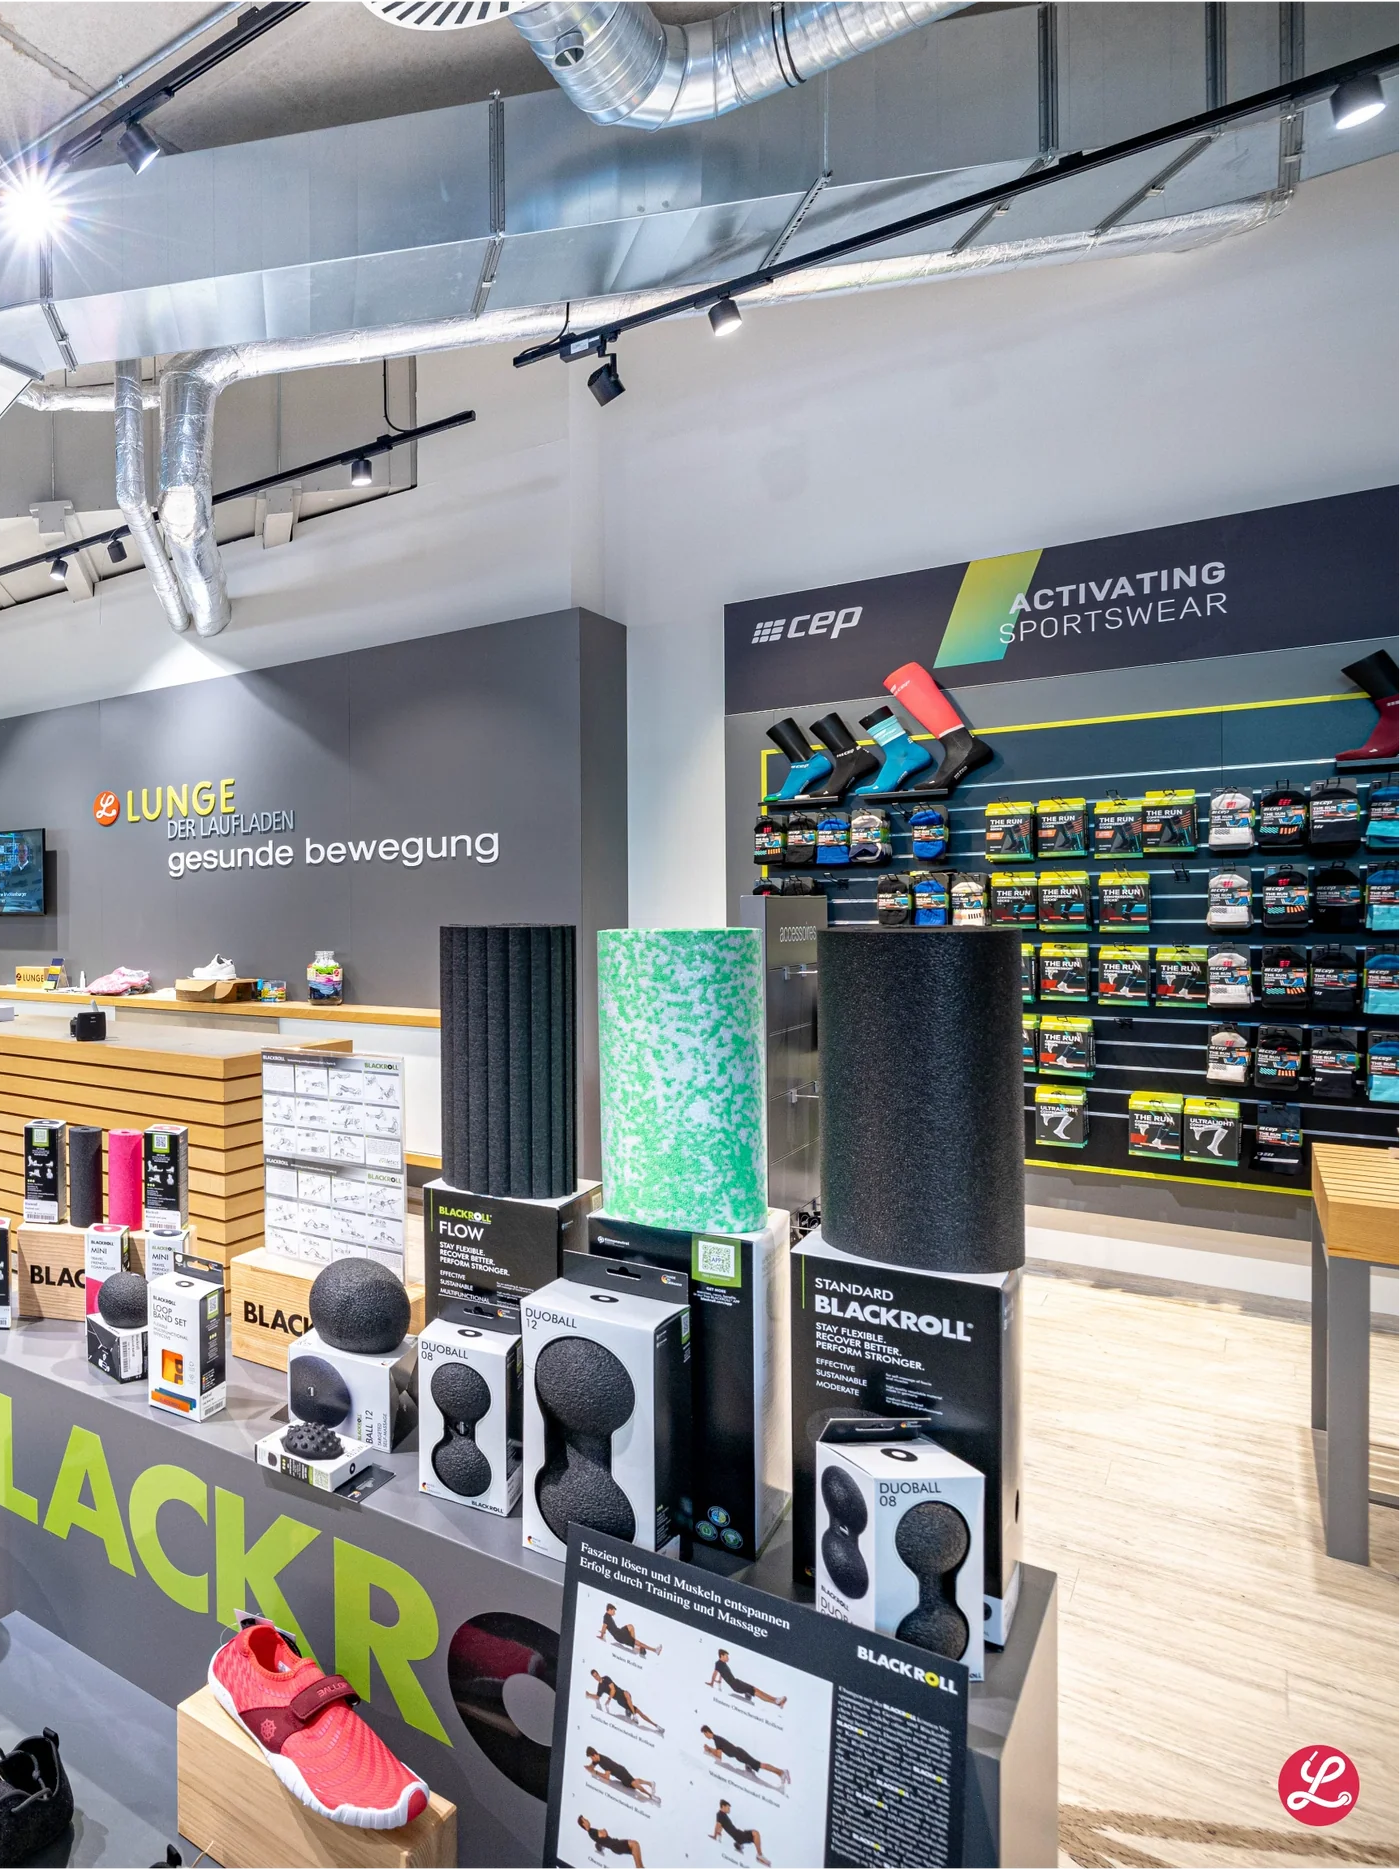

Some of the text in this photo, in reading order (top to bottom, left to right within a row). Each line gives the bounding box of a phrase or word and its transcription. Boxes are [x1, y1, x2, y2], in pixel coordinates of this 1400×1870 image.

[1009, 562, 1226, 615] ACTIVATING
[787, 606, 863, 640] cep
[999, 592, 1228, 644] SPORTSWEAR
[126, 778, 236, 823] LUNGE
[167, 810, 295, 839] DER LAUFLADEN
[168, 831, 499, 877] gesunde bewegung
[1059, 888, 1078, 896] RUN
[1120, 888, 1141, 896] RUN
[779, 921, 817, 943] accessoires
[1179, 965, 1200, 973] RUN
[22, 973, 44, 983] LUNGE
[1044, 1033, 1061, 1041] THE
[364, 1062, 399, 1071] BLACKROLL
[1134, 1113, 1173, 1123] THE RUN
[368, 1173, 402, 1184] BLACKROLL
[439, 1206, 491, 1223] BLACKROLL
[440, 1221, 484, 1241] FLOW
[440, 1242, 485, 1256] STAY FLEXIBLE.
[440, 1249, 496, 1266] RECOVER BETTER.
[440, 1257, 510, 1276] PERFORM STRONGER.
[440, 1270, 466, 1280] EFFECTIVE
[440, 1279, 474, 1291] SUSTAINABLE
[815, 1277, 894, 1302] STANDARD
[153, 1295, 176, 1306] BLACKROLL
[440, 1288, 490, 1304] MULTIFUNCTIONAL
[153, 1303, 173, 1315] LOOP
[153, 1311, 187, 1327] BAND SET
[525, 1307, 577, 1329] DUOBALL
[526, 1318, 537, 1330] 12
[815, 1294, 972, 1343] BLACKROLL
[816, 1322, 887, 1344] STAY FLEXIBLE.
[421, 1340, 469, 1360] DUOBALL
[816, 1332, 902, 1357] RECOVER BETTER.
[421, 1351, 433, 1361] 08
[816, 1341, 925, 1371] PERFORM STRONGER.
[816, 1358, 855, 1373] EFFECTIVE
[816, 1369, 867, 1387] SUSTAINABLE
[816, 1381, 859, 1396] MODERATE
[365, 1410, 373, 1420] 12
[879, 1482, 942, 1494] DUOBALL
[471, 1500, 504, 1514] BLACKROLL
[879, 1495, 897, 1507] 08
[581, 1541, 791, 1631] Faszien lösen und Muskeln entspannen
[579, 1556, 769, 1638] Erfolg durch Training und Massage
[821, 1584, 850, 1612] BLACKROLL
[820, 1596, 854, 1625] DUOB
[857, 1645, 958, 1695] BLACKROLL
